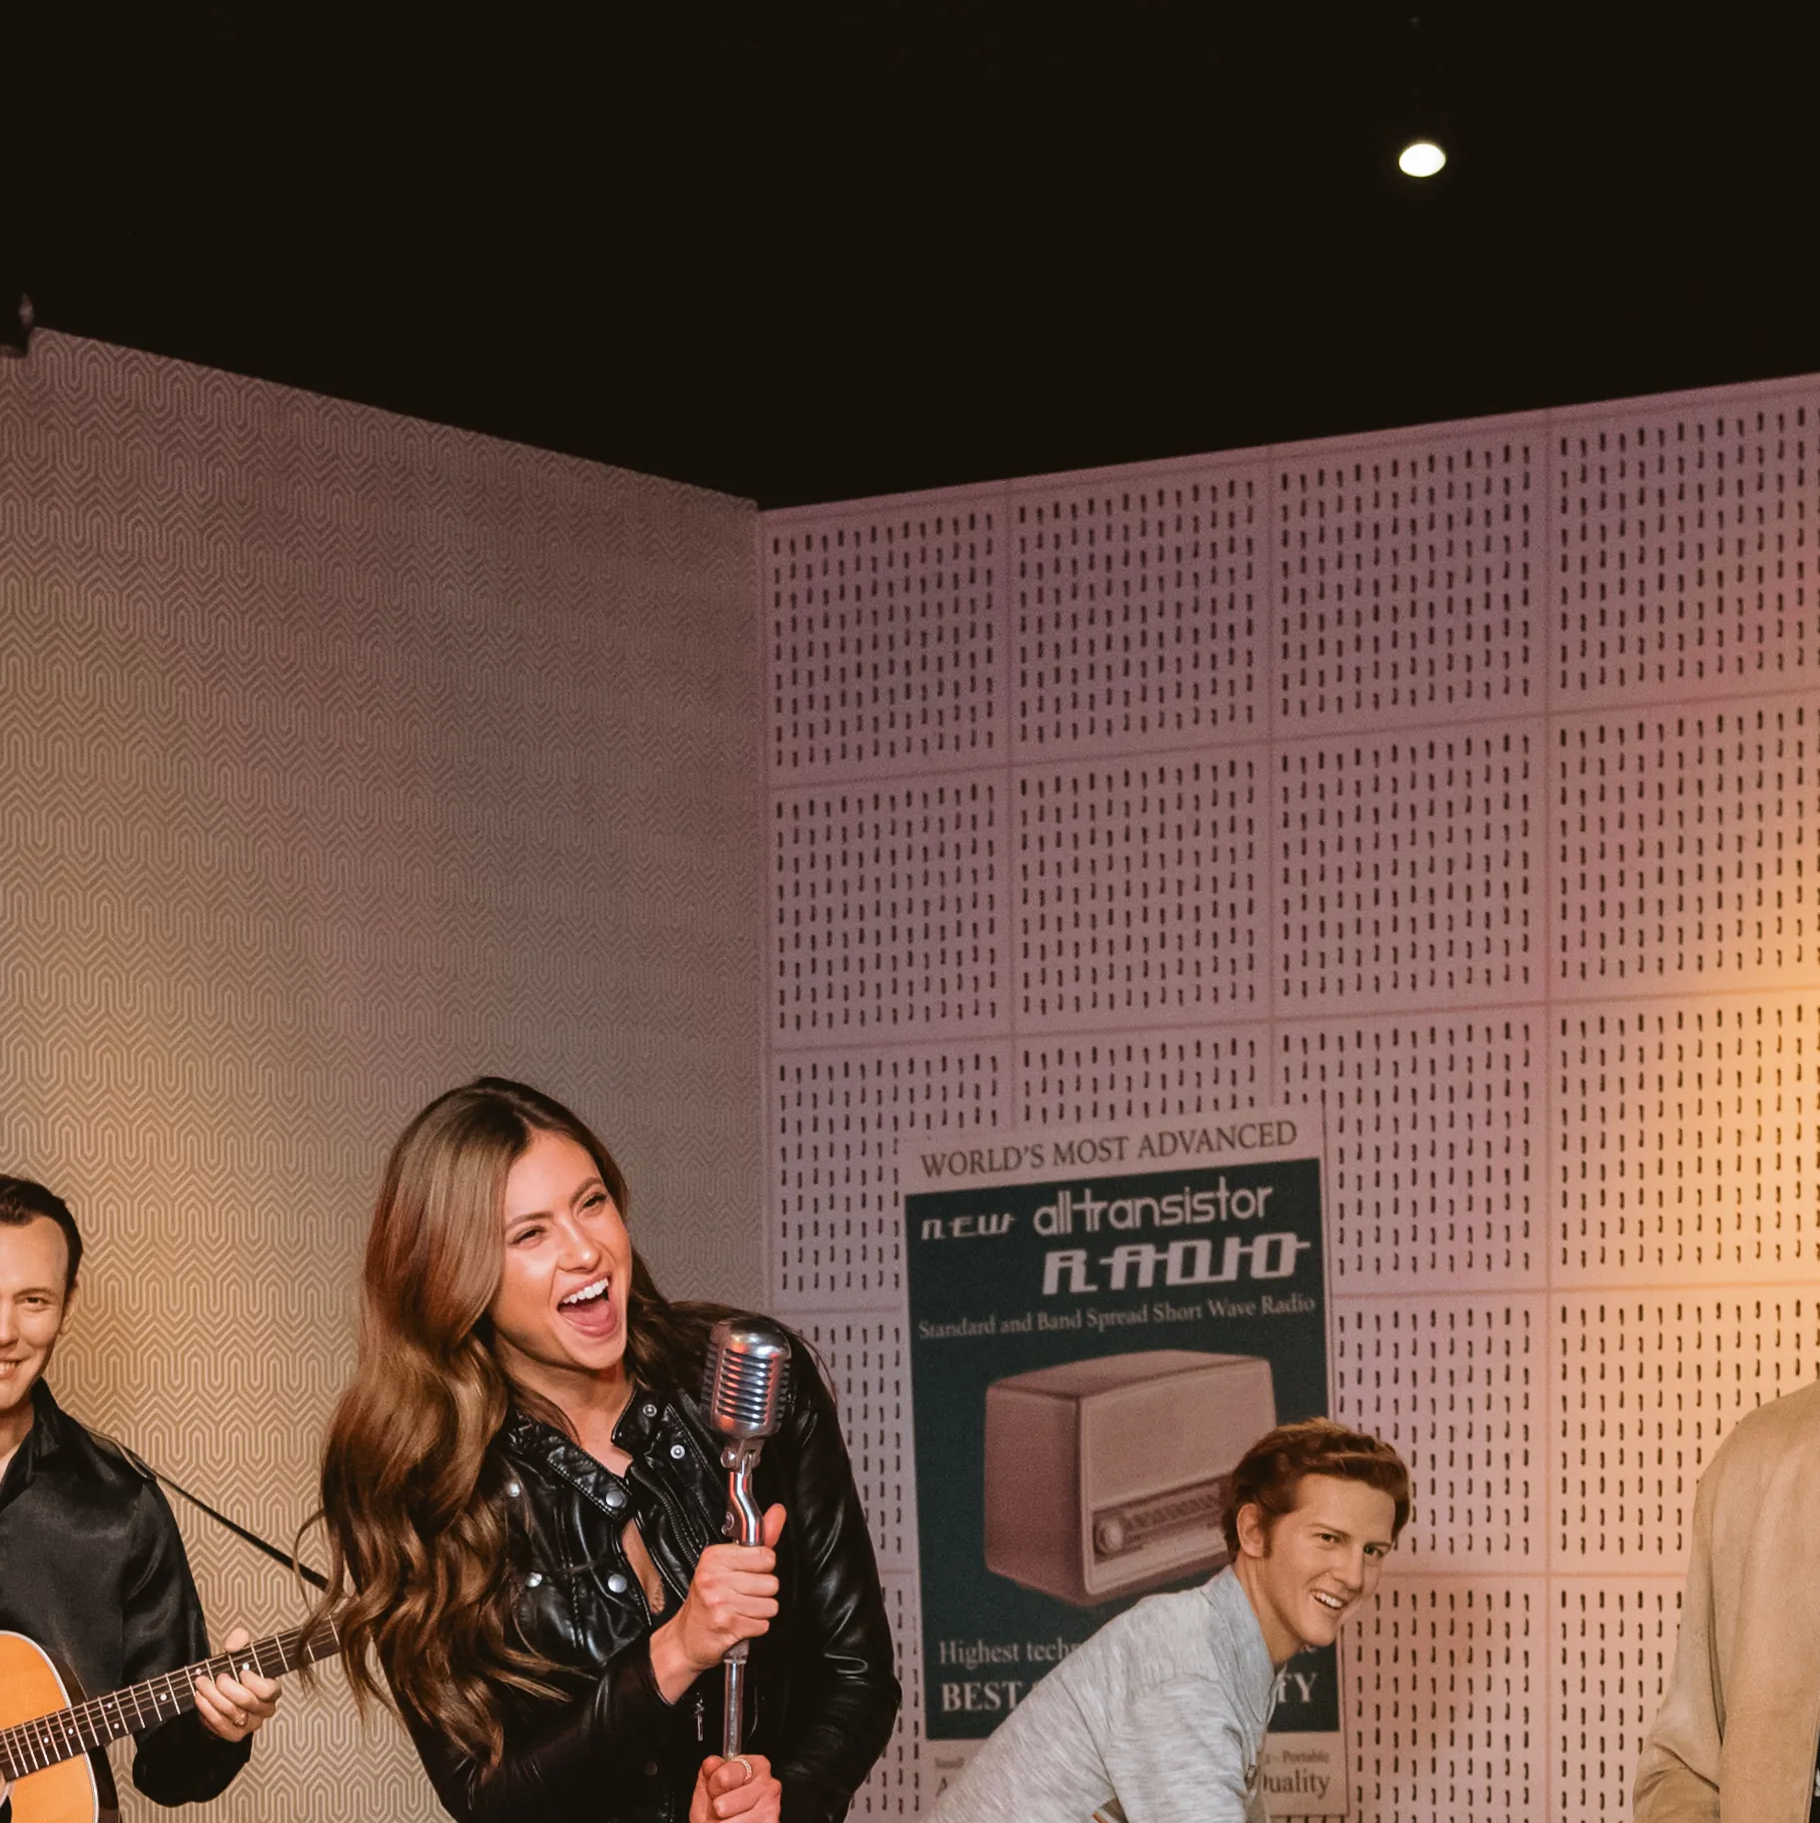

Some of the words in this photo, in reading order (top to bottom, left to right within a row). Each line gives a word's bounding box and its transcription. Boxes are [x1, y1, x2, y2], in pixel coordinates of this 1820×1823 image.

[921, 1143, 1045, 1179] WORLD'S
[1053, 1135, 1130, 1168] MOST
[1137, 1119, 1298, 1161] ADVANCED
[921, 1213, 1016, 1240] new
[1042, 1232, 1312, 1296] RADIO
[918, 1313, 996, 1340] Standard
[1000, 1312, 1032, 1334] and
[1037, 1309, 1082, 1331] Band
[1087, 1306, 1148, 1331] Spread
[1153, 1300, 1202, 1322] Short
[1207, 1299, 1256, 1318] Wave
[1261, 1293, 1317, 1316] Radio
[939, 1639, 1019, 1670] Highest
[942, 1680, 1022, 1711] BEST
[1263, 1768, 1331, 1799] uality
